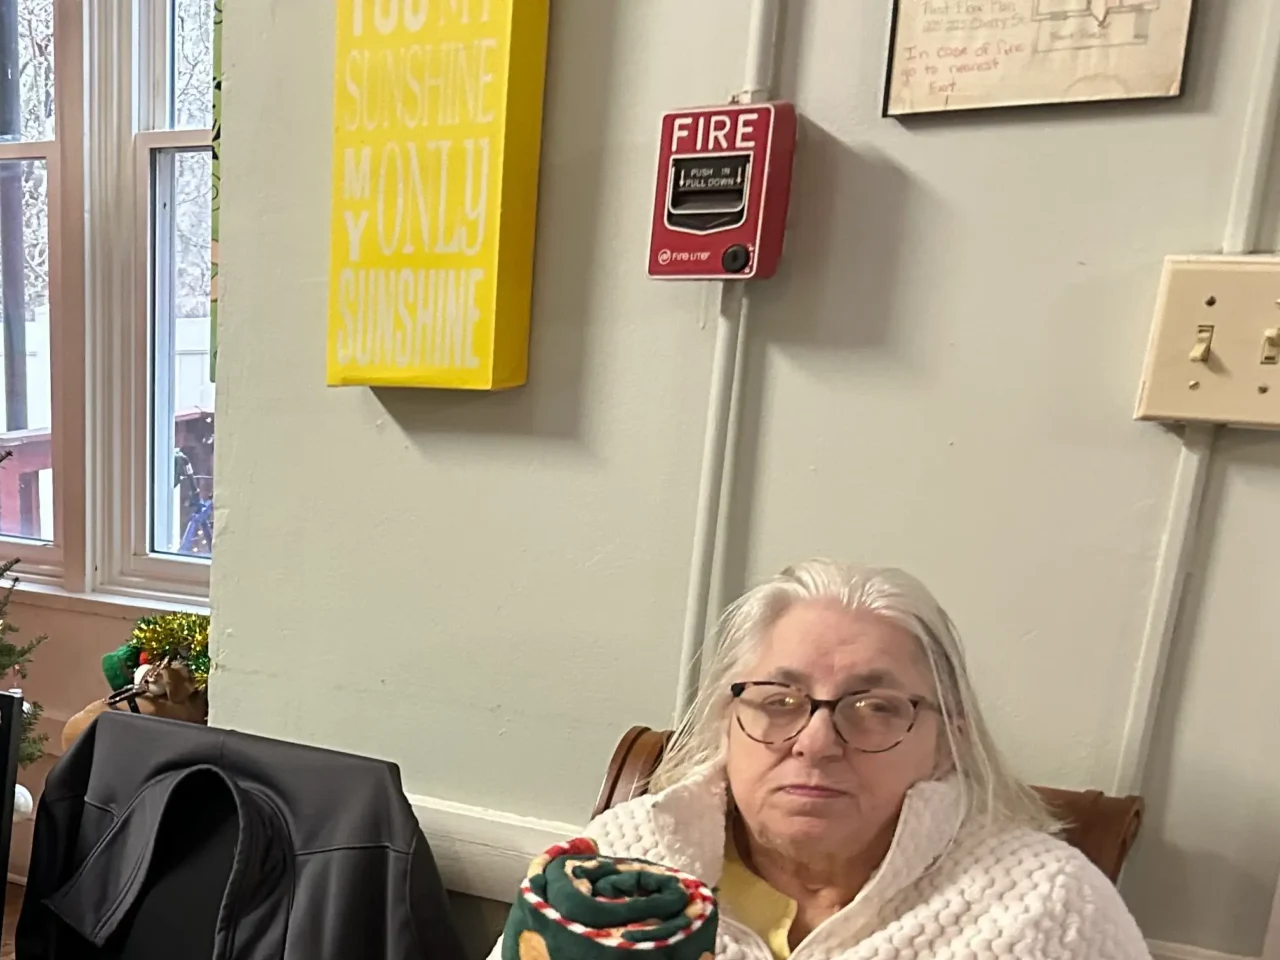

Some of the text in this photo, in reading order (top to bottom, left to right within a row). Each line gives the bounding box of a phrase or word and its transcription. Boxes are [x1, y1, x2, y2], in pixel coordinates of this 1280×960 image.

[905, 46, 929, 61] In
[975, 43, 992, 57] of
[925, 64, 938, 75] to
[343, 39, 497, 131] SUNSHINE
[671, 113, 759, 152] FIRE
[685, 176, 735, 187] PULL DOWN
[690, 167, 730, 177] PUSH IN
[377, 138, 491, 257] ONLY
[336, 267, 485, 369] SUNSHINE
